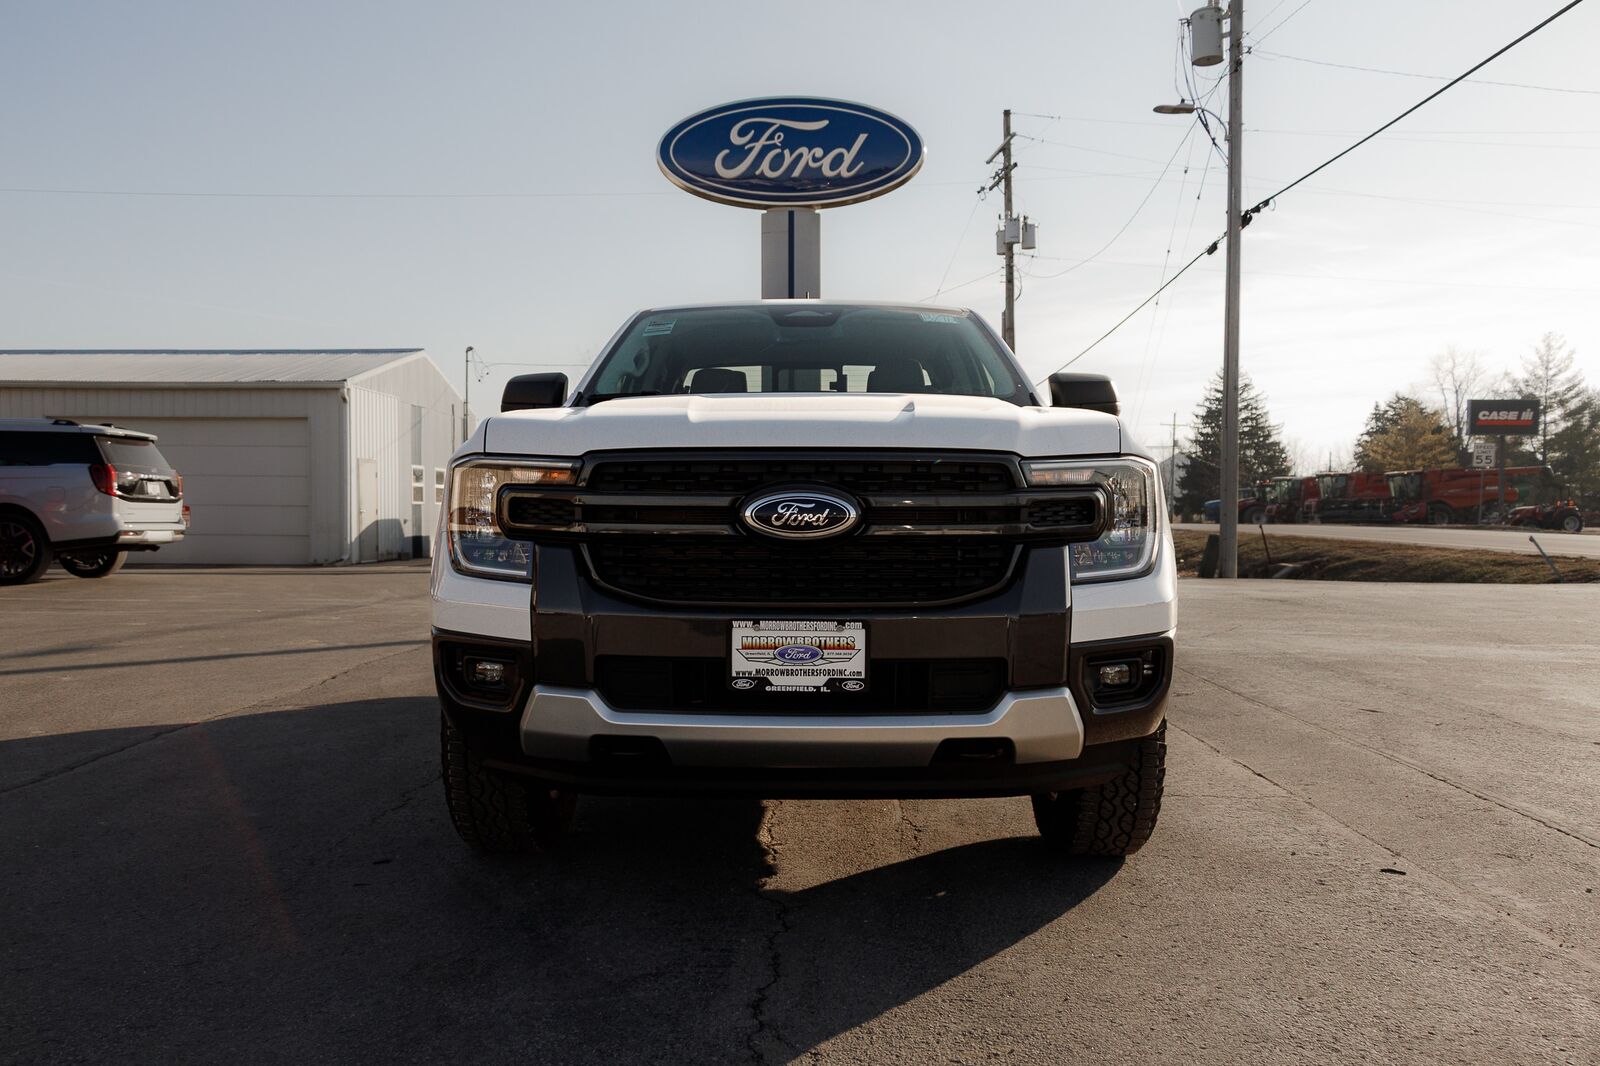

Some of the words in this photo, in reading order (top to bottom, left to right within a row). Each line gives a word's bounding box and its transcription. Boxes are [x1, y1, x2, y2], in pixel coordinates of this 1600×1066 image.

[715, 117, 869, 179] Ford
[1478, 410, 1519, 420] CASE
[1475, 455, 1493, 465] 55
[771, 502, 830, 526] Ford
[784, 647, 812, 660] Ford
[765, 685, 817, 693] GREENFIELD,
